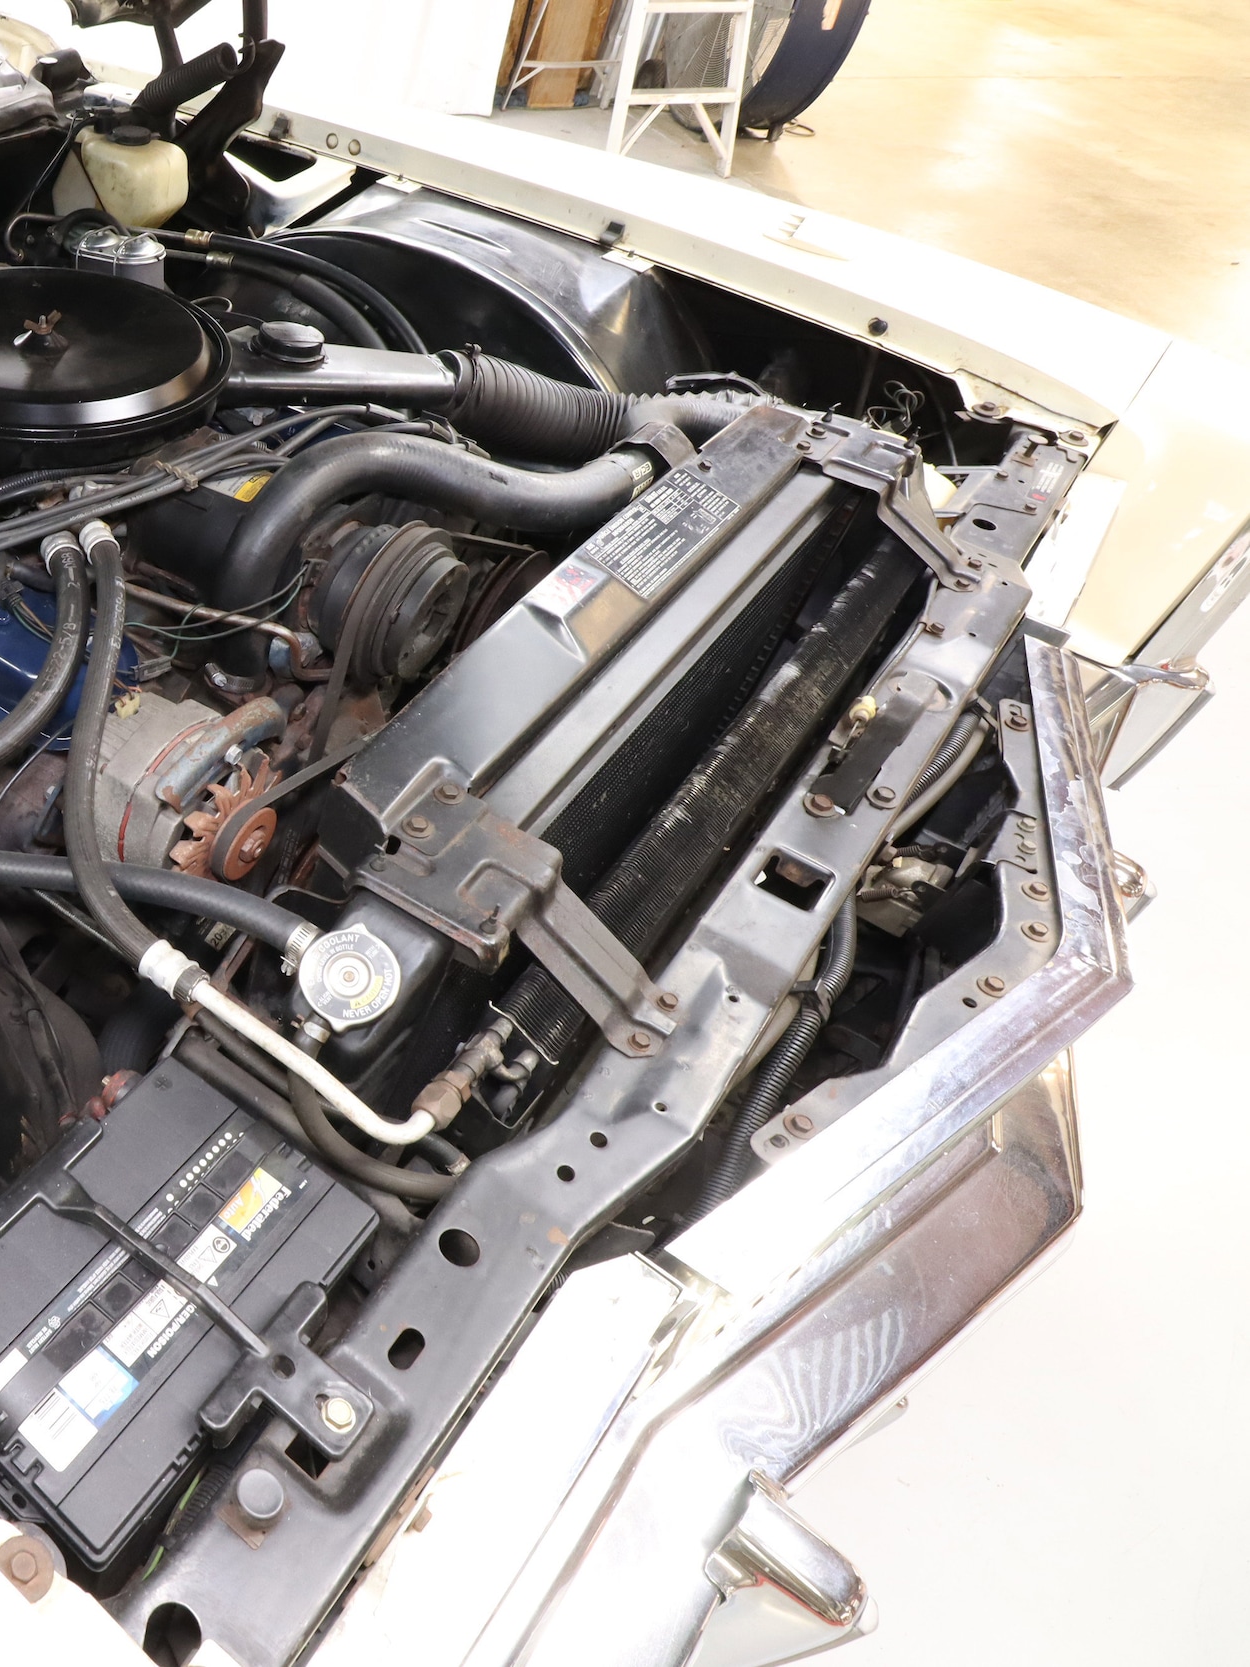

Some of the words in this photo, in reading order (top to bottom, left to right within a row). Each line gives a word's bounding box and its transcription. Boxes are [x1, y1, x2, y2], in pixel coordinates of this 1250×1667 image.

[318, 934, 360, 952] COOLANT
[335, 944, 354, 952] BOTTLE
[342, 1006, 371, 1018] NEVER
[372, 987, 390, 1009] OPEN
[384, 969, 393, 986] HOT
[221, 1195, 245, 1220] Auto
[240, 1184, 292, 1242] Federated
[145, 1300, 197, 1358] GER/POISON
